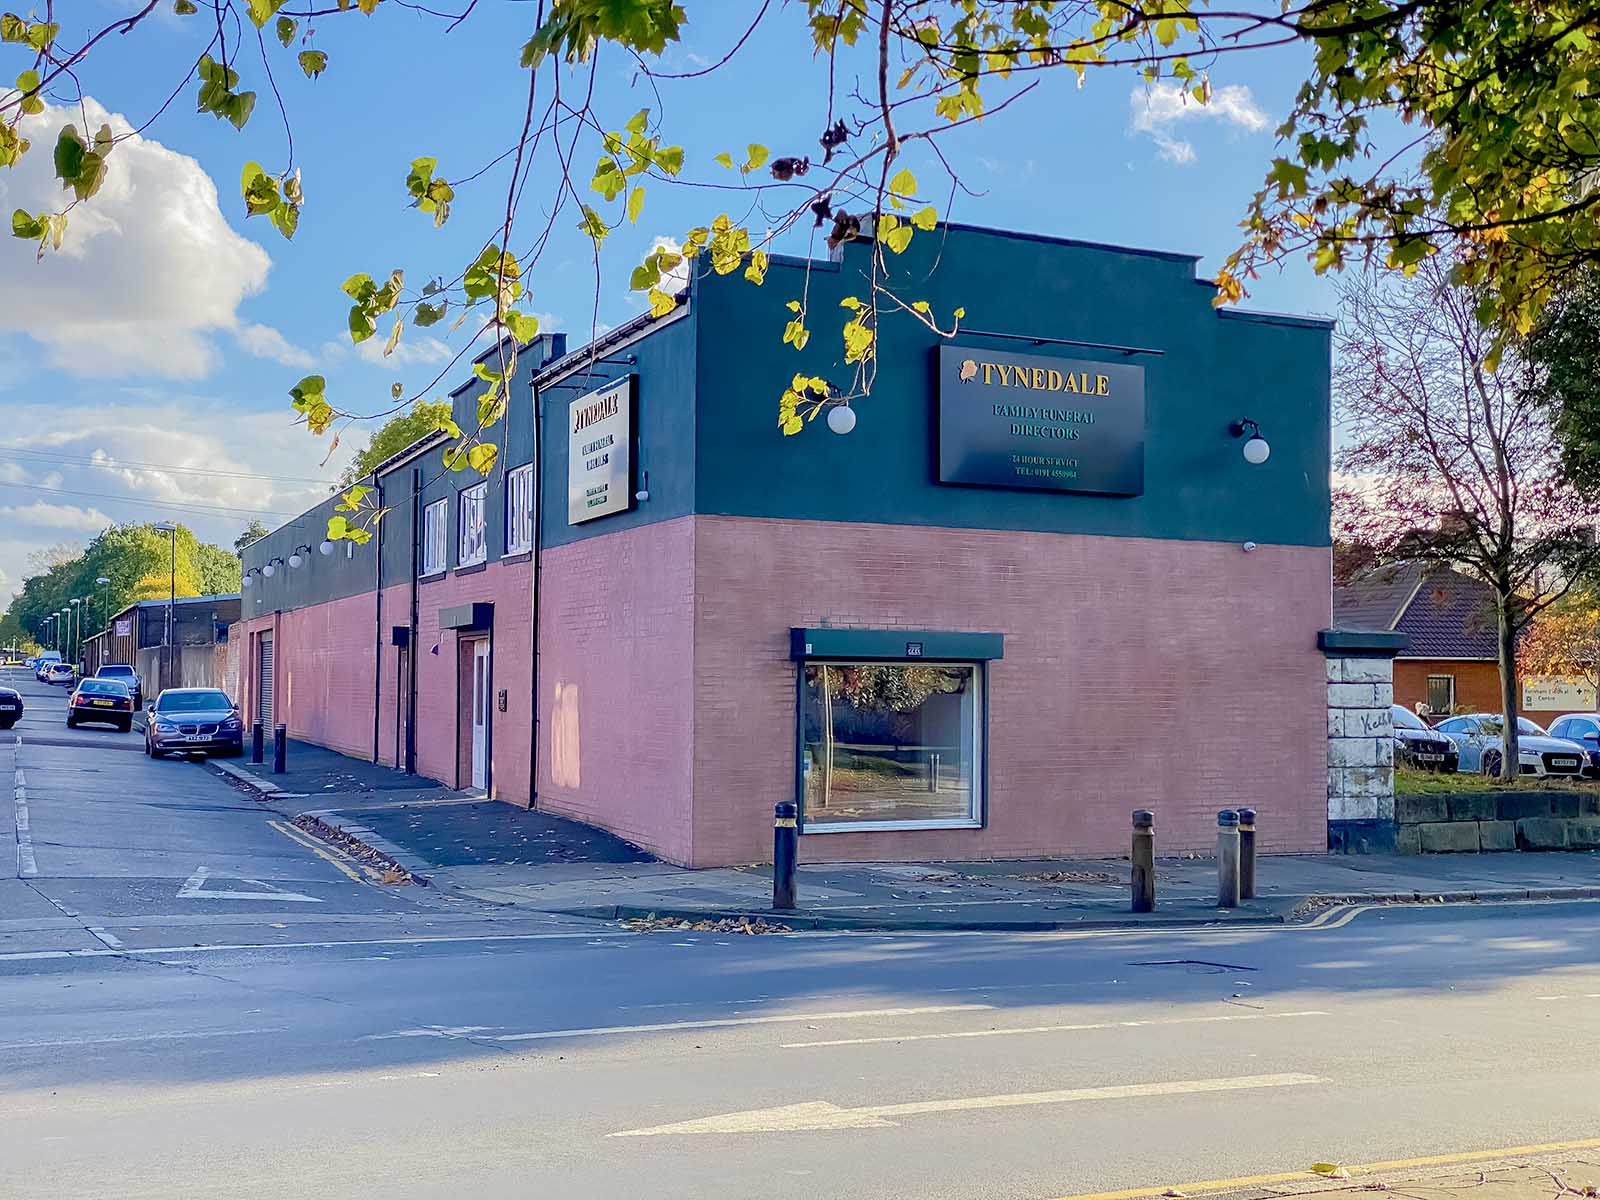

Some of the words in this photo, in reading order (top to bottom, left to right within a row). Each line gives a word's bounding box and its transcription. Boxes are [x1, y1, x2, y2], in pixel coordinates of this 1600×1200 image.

[979, 362, 1110, 397] TYNEDALE
[579, 394, 618, 430] TYNEDALE
[993, 404, 1038, 419] FAMILY
[1040, 408, 1096, 424] FUNERAL
[1010, 423, 1080, 440] DIRECTORS
[1021, 455, 1045, 465] HOUR
[1045, 457, 1078, 467] SERVICE
